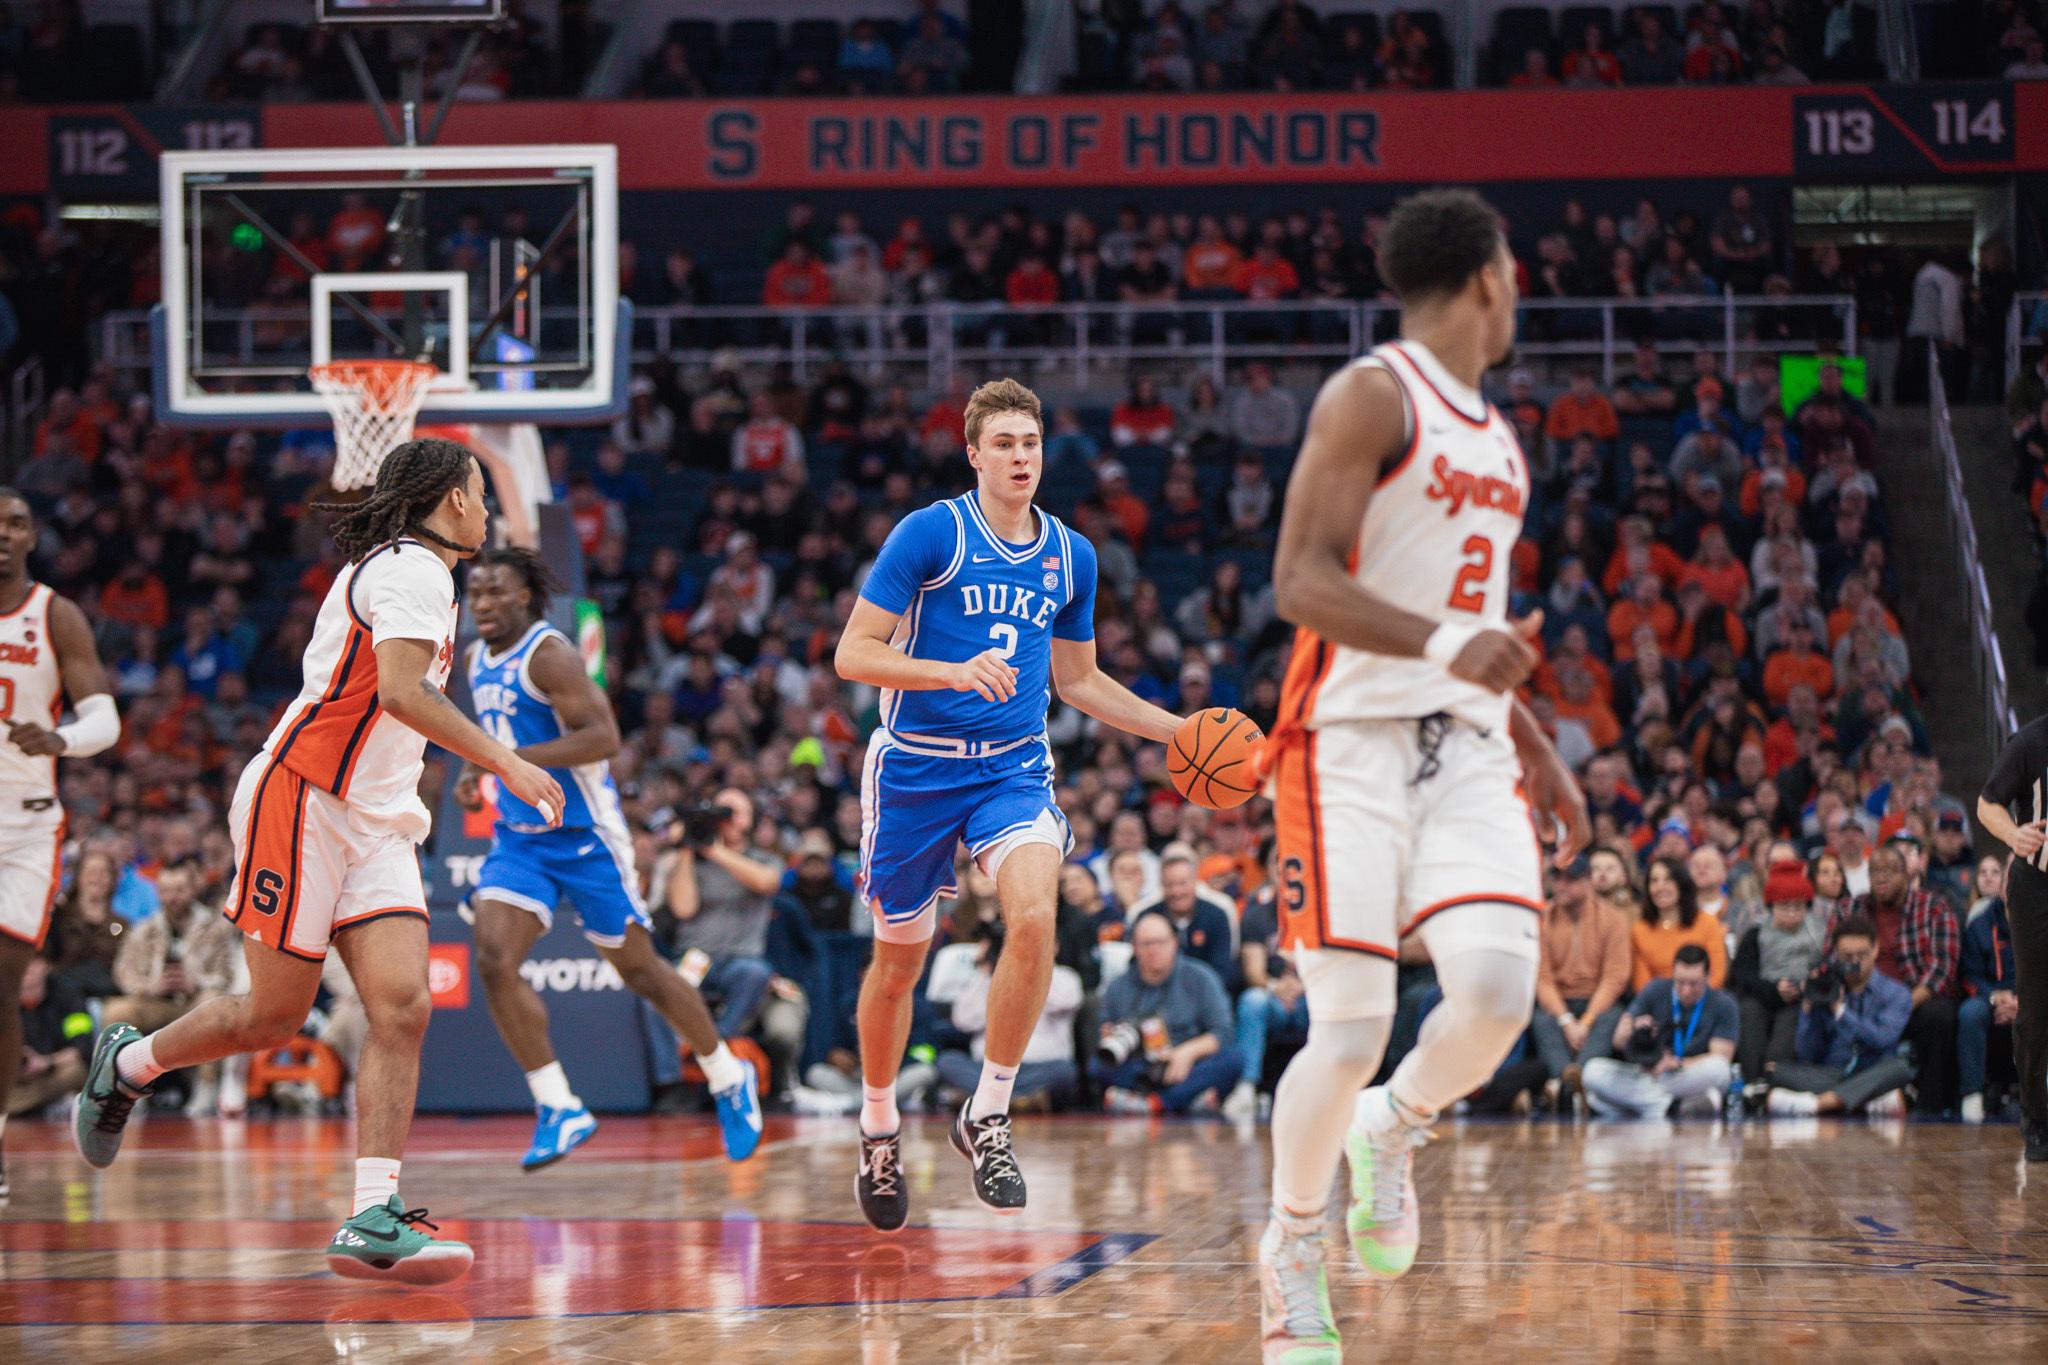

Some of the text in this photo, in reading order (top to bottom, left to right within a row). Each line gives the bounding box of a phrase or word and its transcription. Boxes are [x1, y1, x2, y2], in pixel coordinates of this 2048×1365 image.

[709, 110, 1379, 180] S RING OF HONOR
[1804, 109, 1875, 156] 113
[1931, 99, 2007, 145] 114
[58, 128, 129, 176] 112
[1447, 533, 1494, 616] 2
[960, 583, 1059, 630] DUKE
[988, 622, 1019, 661] 2
[251, 866, 285, 917] S
[519, 957, 626, 993] YOTA
